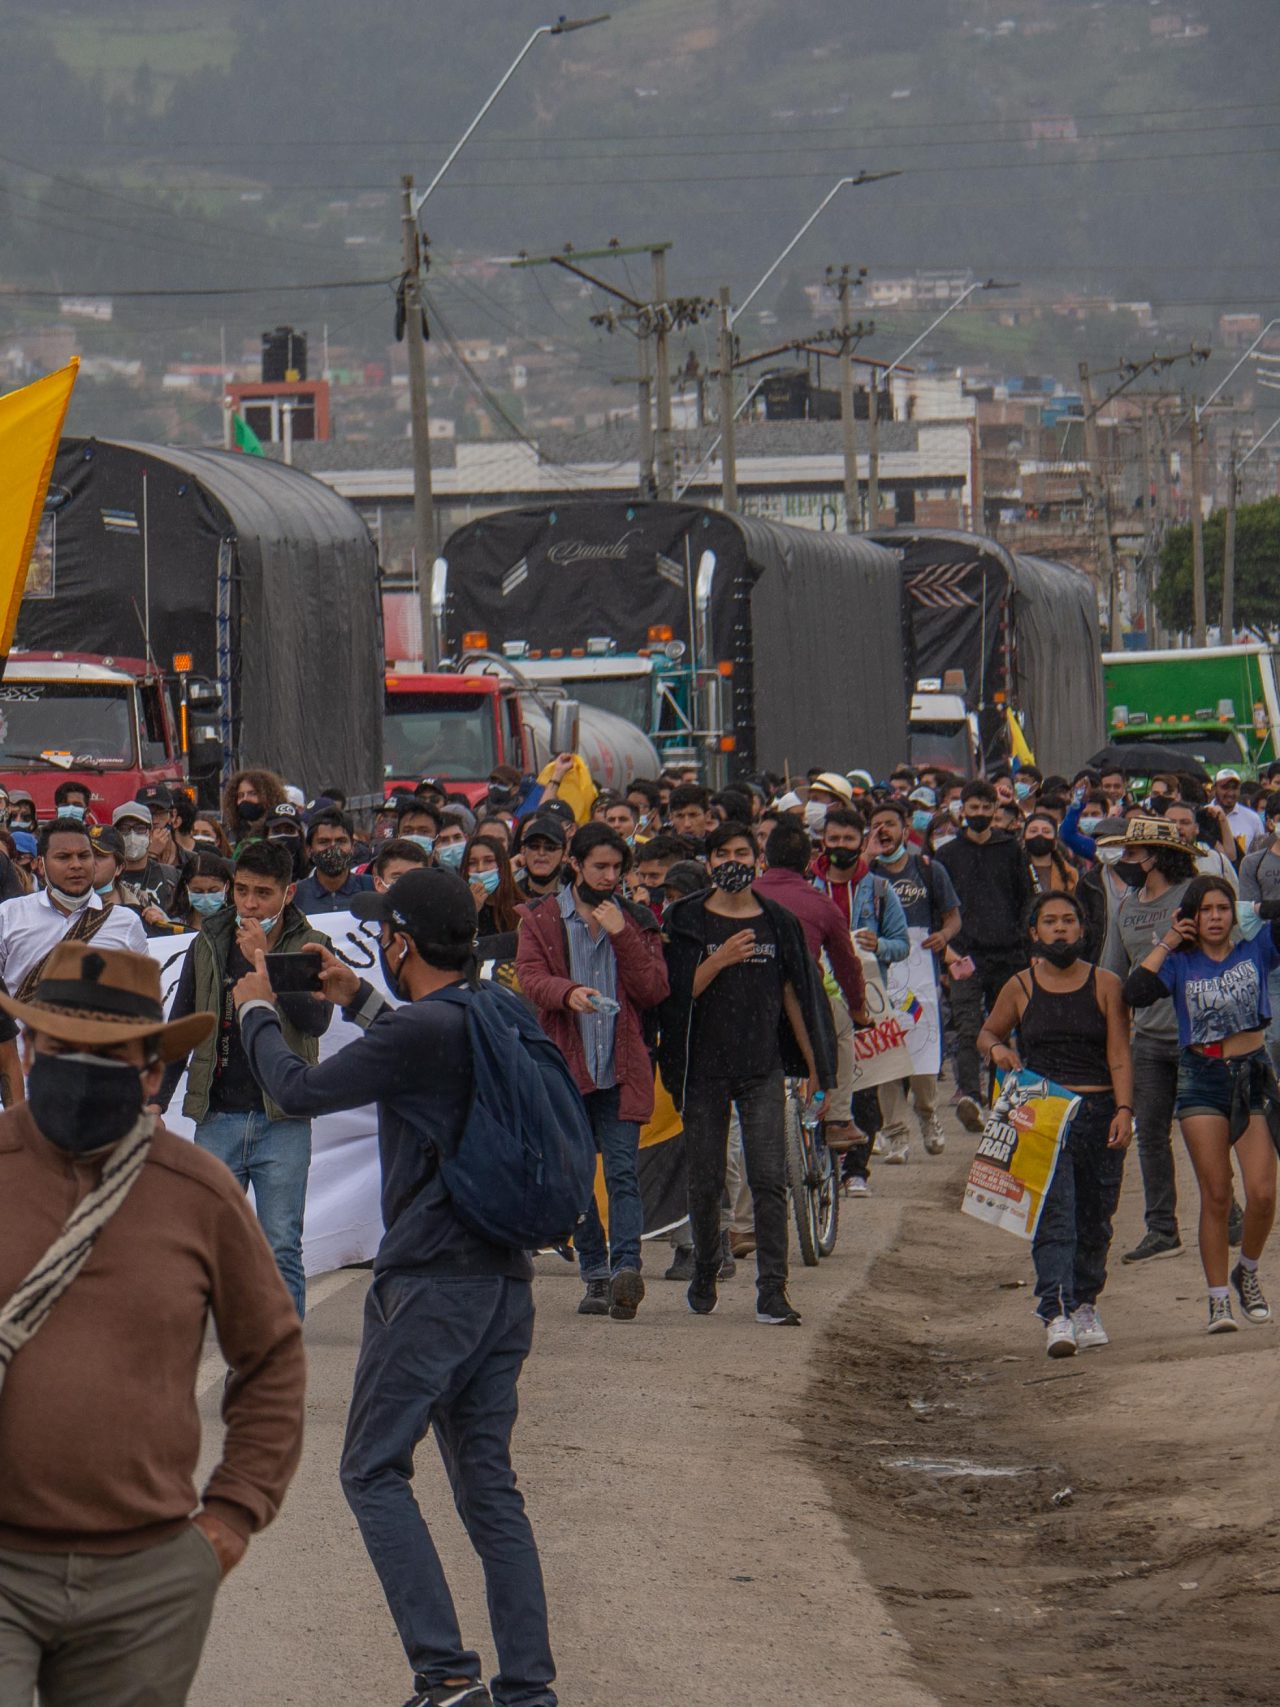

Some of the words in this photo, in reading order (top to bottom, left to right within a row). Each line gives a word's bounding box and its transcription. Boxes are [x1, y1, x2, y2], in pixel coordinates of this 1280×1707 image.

[1123, 909, 1168, 928] EXPLICIT
[854, 1017, 909, 1061] ISTORIA
[983, 1120, 1017, 1146] ENTO
[978, 1138, 1011, 1163] RAR
